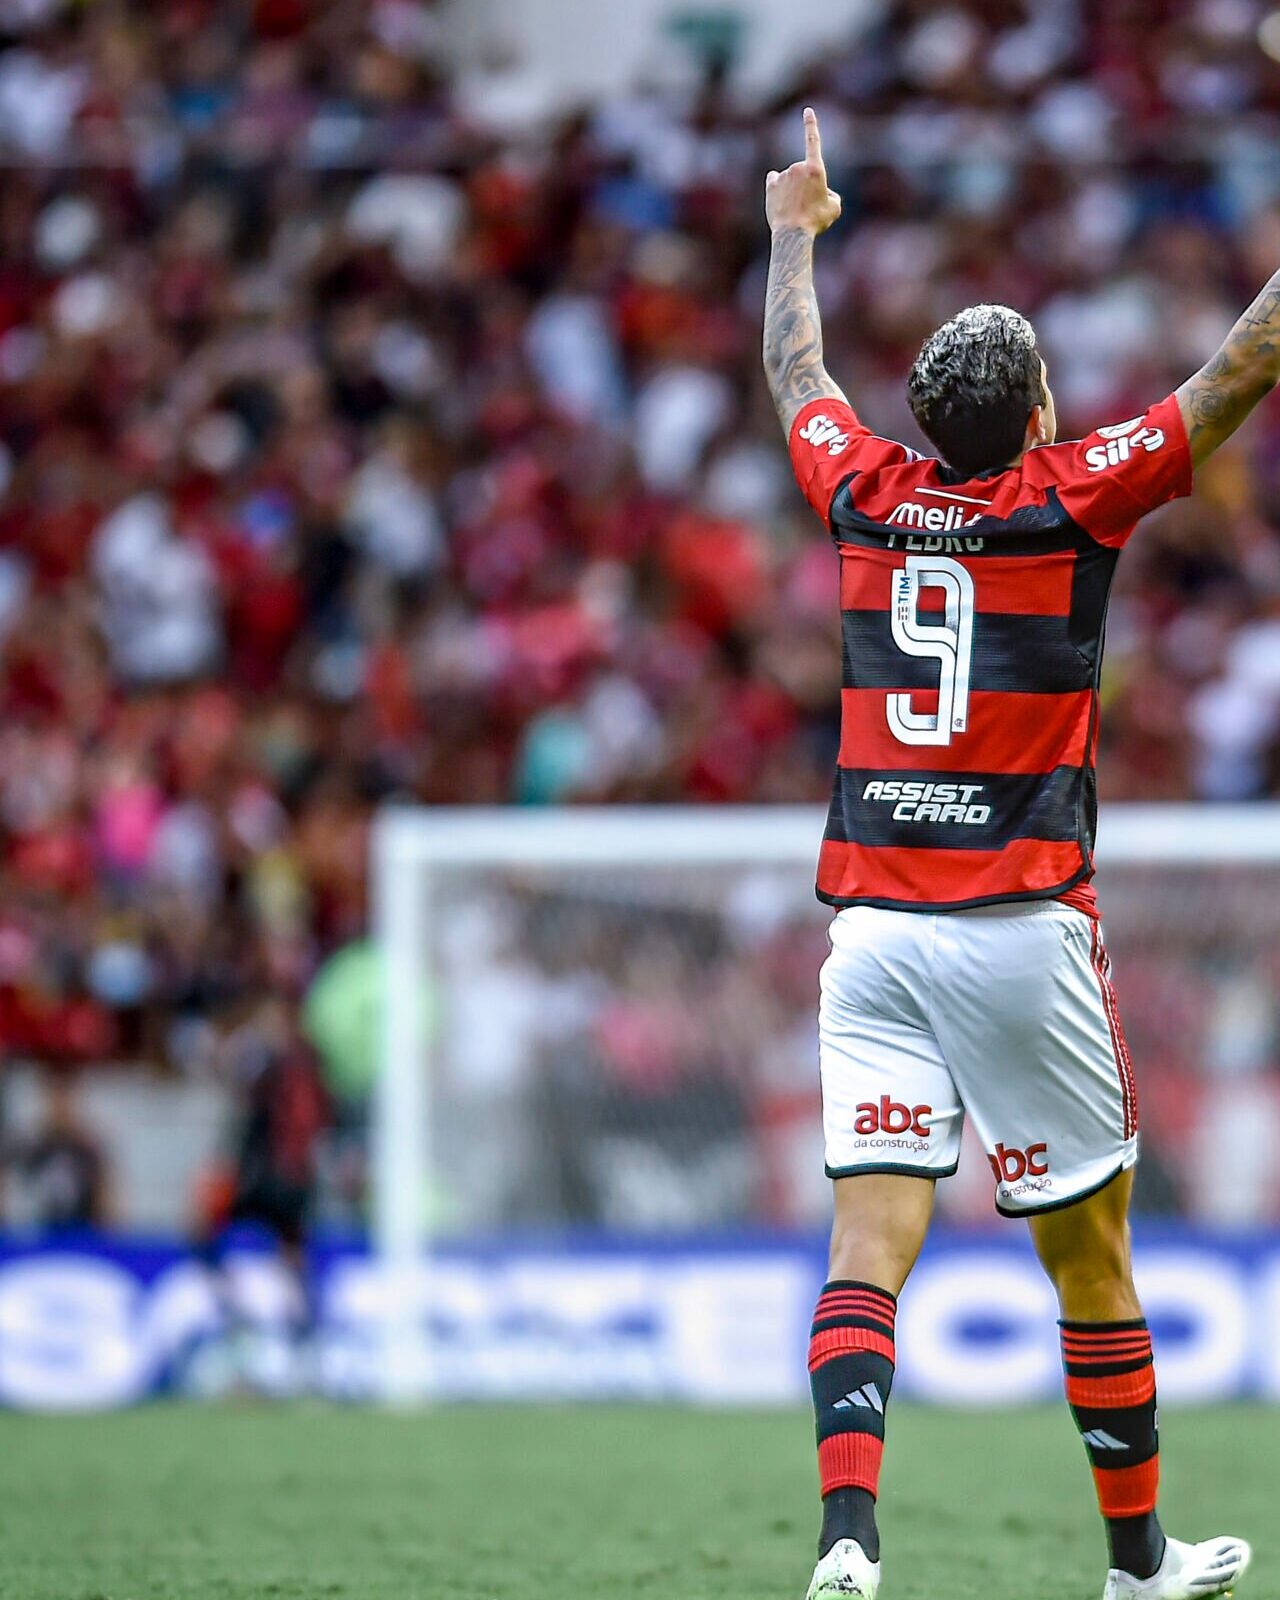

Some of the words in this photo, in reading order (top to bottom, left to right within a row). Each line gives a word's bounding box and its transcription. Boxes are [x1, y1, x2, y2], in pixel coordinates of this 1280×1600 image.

[898, 576, 911, 603] TIM
[886, 555, 975, 746] 9
[862, 781, 984, 803] ASSIST
[892, 803, 991, 824] CARD
[854, 1094, 932, 1137] abc
[854, 1139, 867, 1149] da
[870, 1139, 930, 1152] construção
[1001, 1179, 1053, 1198] onstrução
